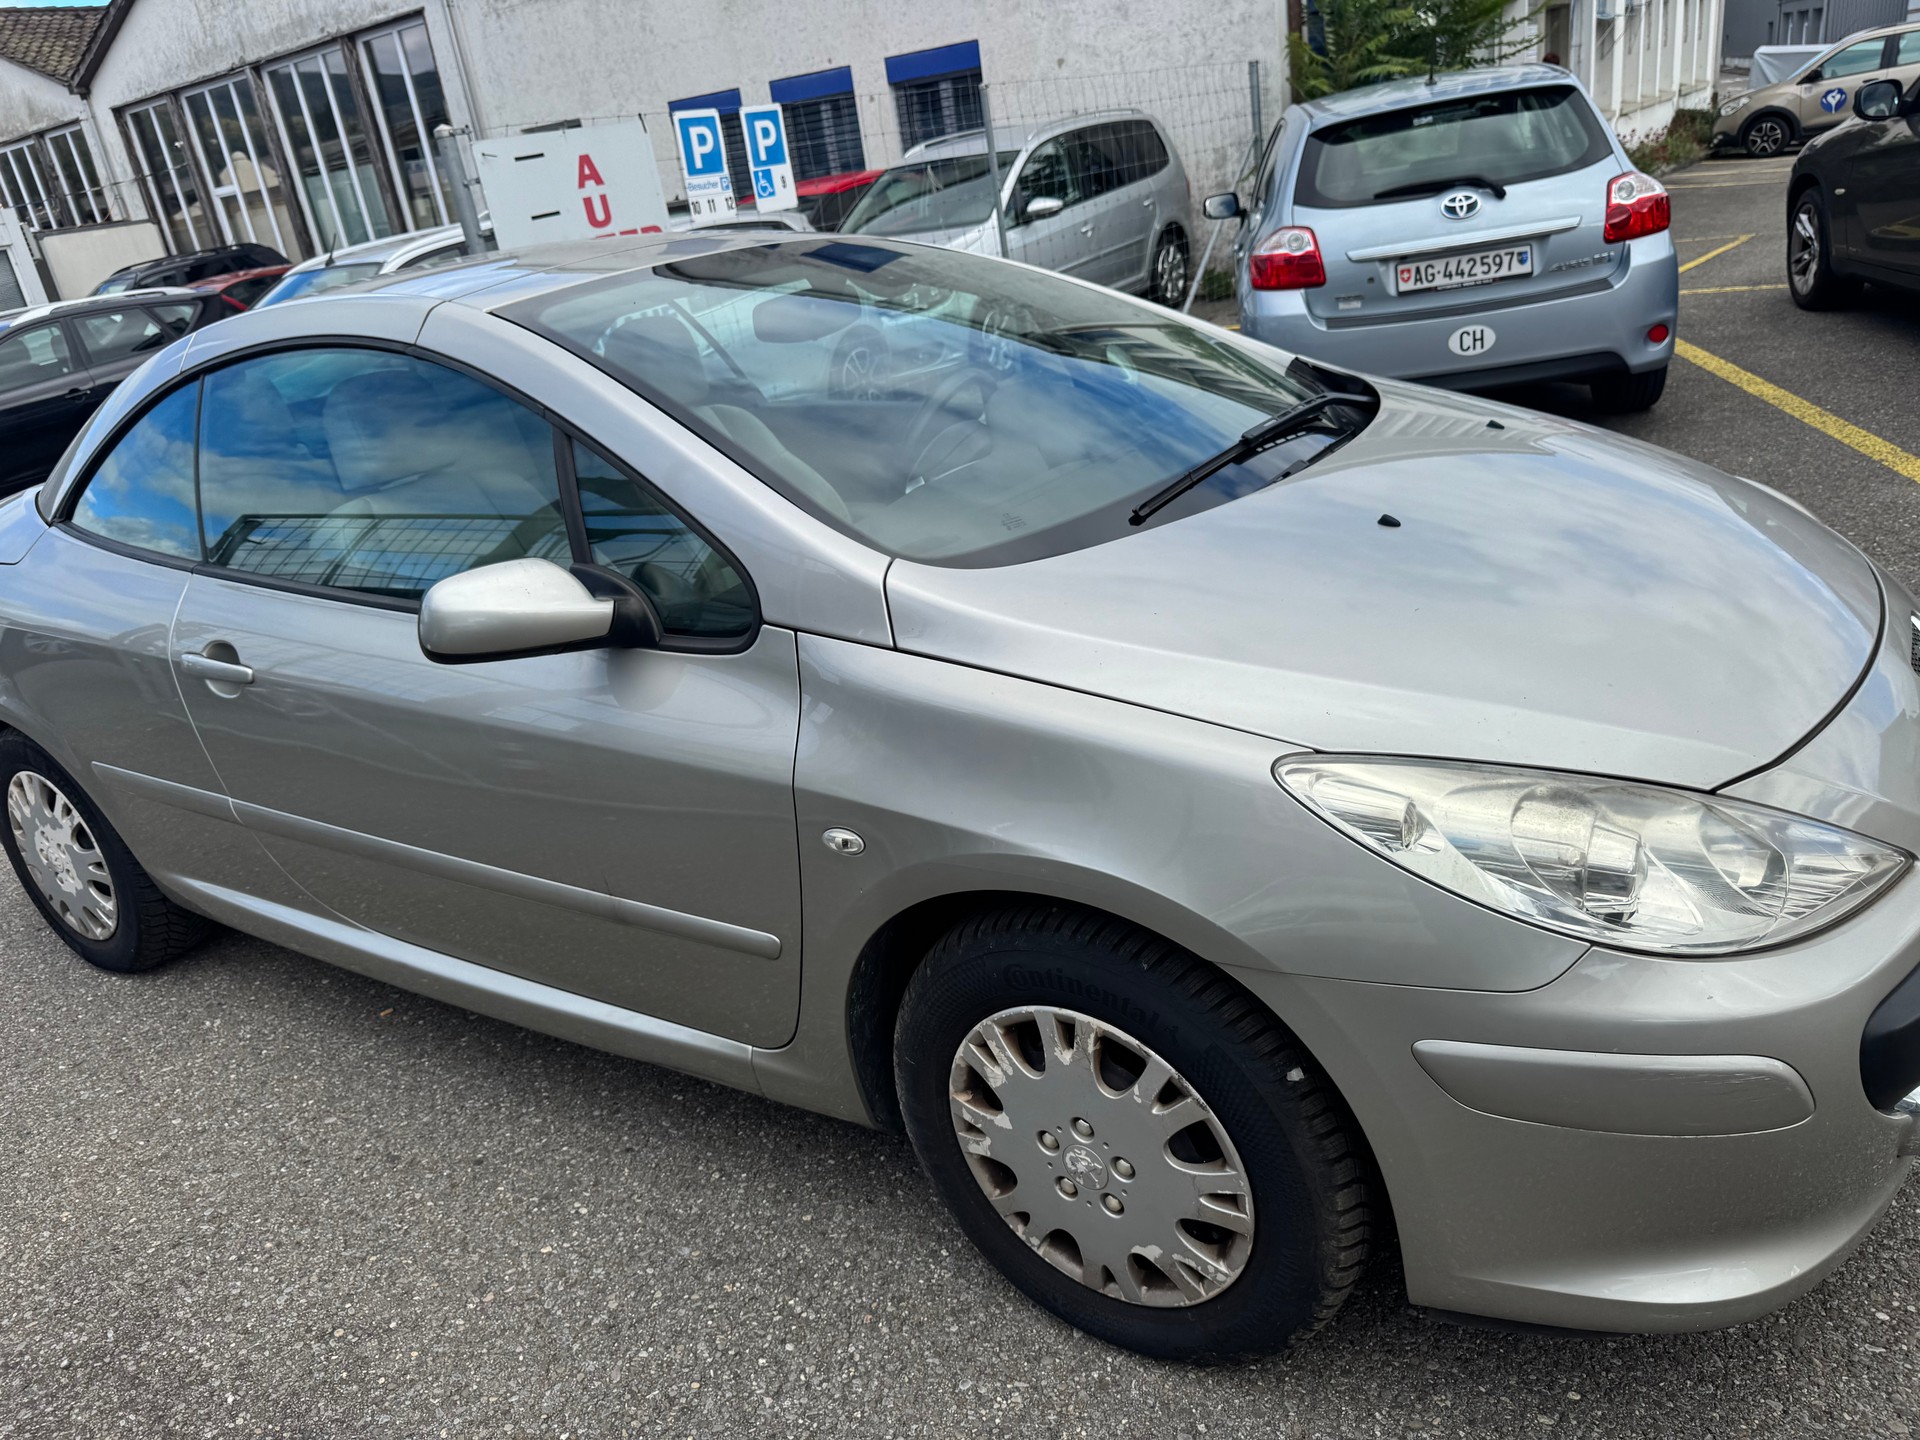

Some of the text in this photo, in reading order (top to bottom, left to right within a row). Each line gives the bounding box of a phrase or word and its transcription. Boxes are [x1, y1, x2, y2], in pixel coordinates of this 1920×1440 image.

[689, 126, 714, 169] P
[753, 120, 777, 161] P
[687, 180, 719, 192] Besucher
[691, 196, 735, 215] 10 11 12
[1459, 329, 1485, 352] CH
[1002, 963, 1161, 1032] Continental
